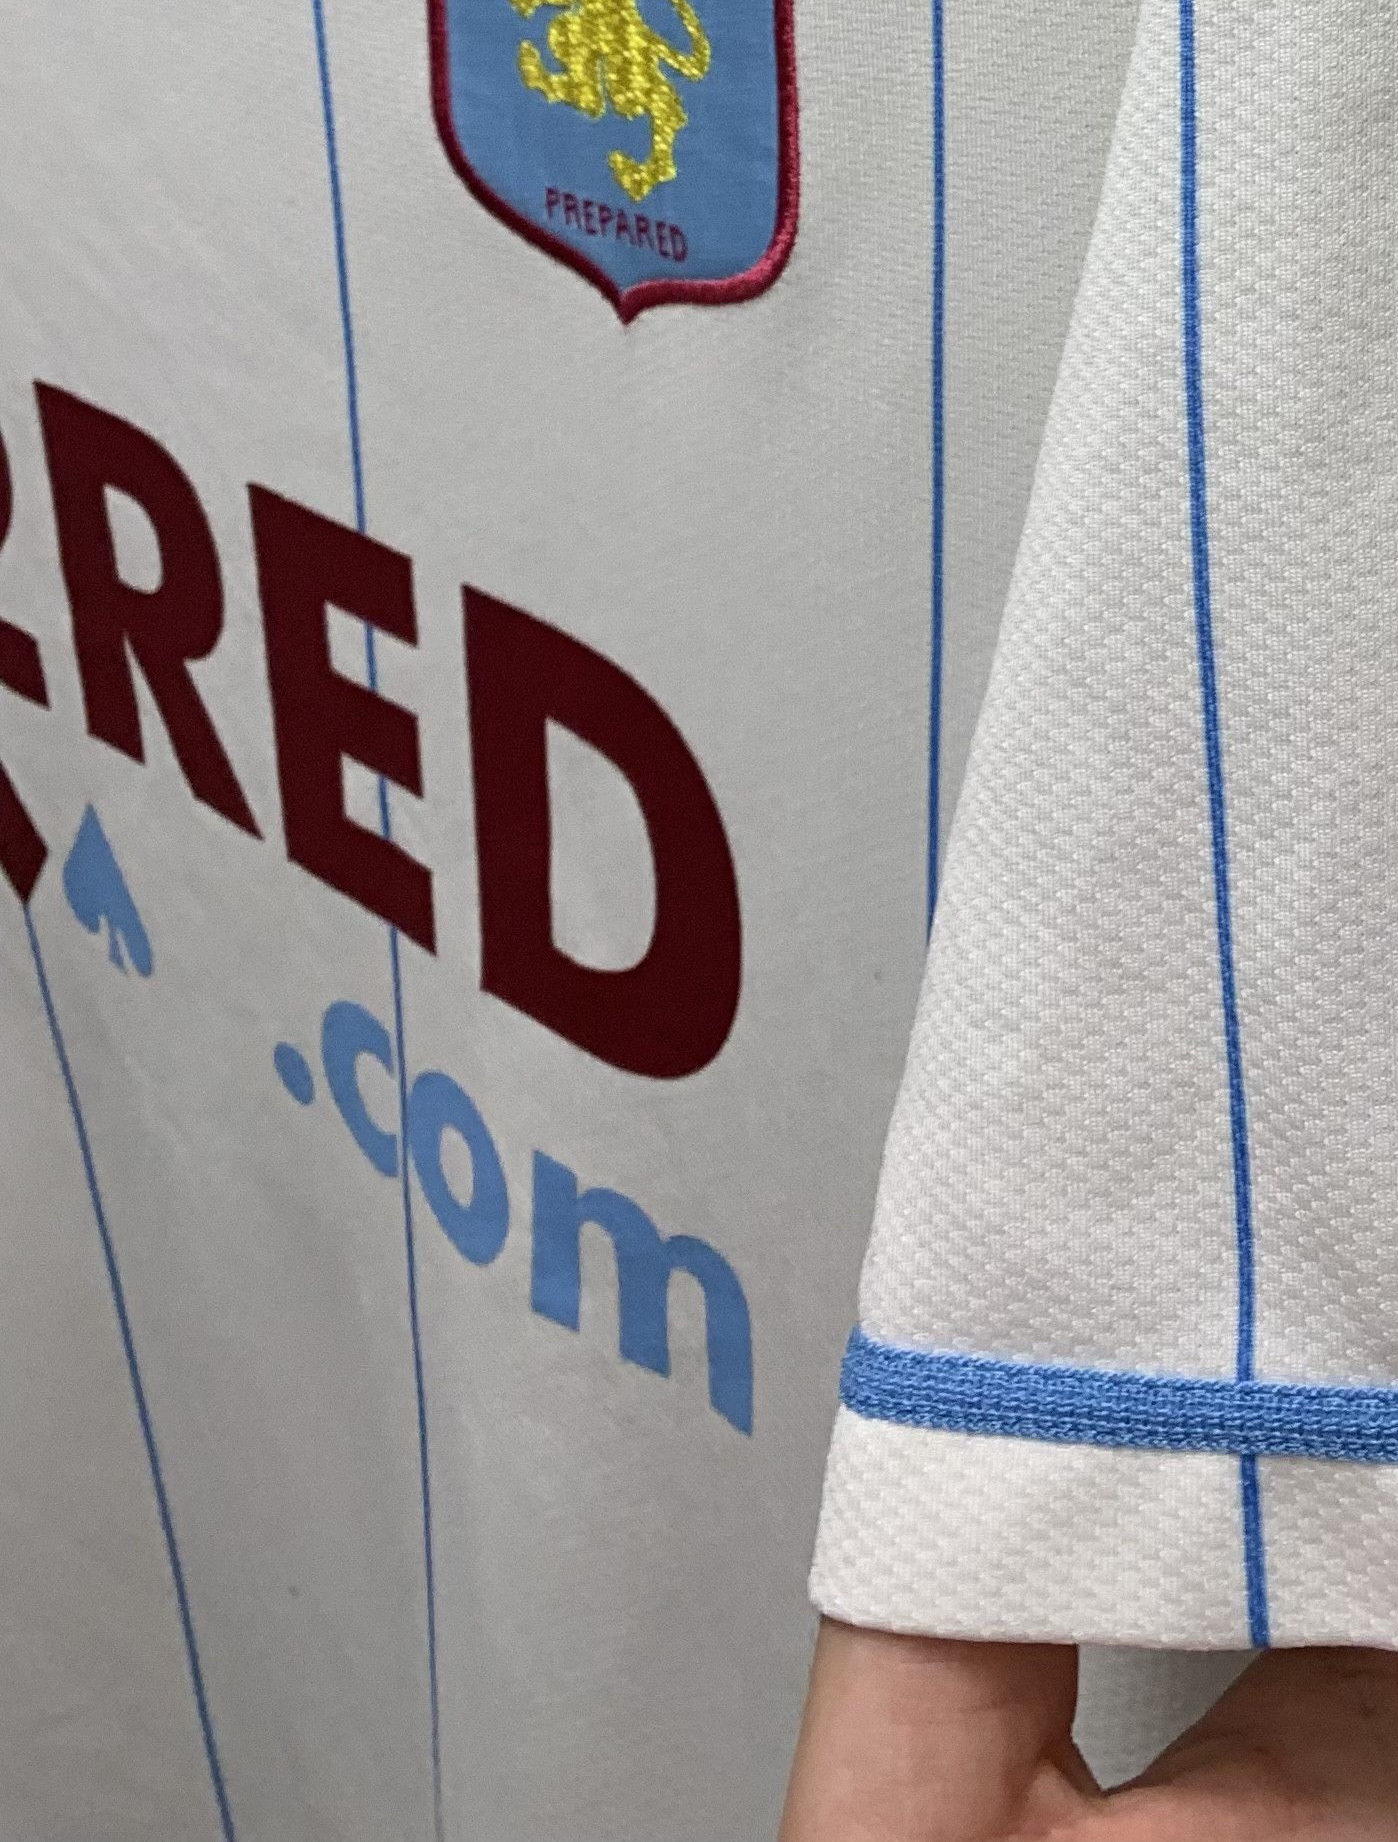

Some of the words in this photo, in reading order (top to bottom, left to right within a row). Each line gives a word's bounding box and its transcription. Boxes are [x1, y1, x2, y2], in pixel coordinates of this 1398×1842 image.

[545, 185, 688, 262] PREPARED
[0, 377, 743, 1081] RED
[273, 999, 753, 1437] .com
